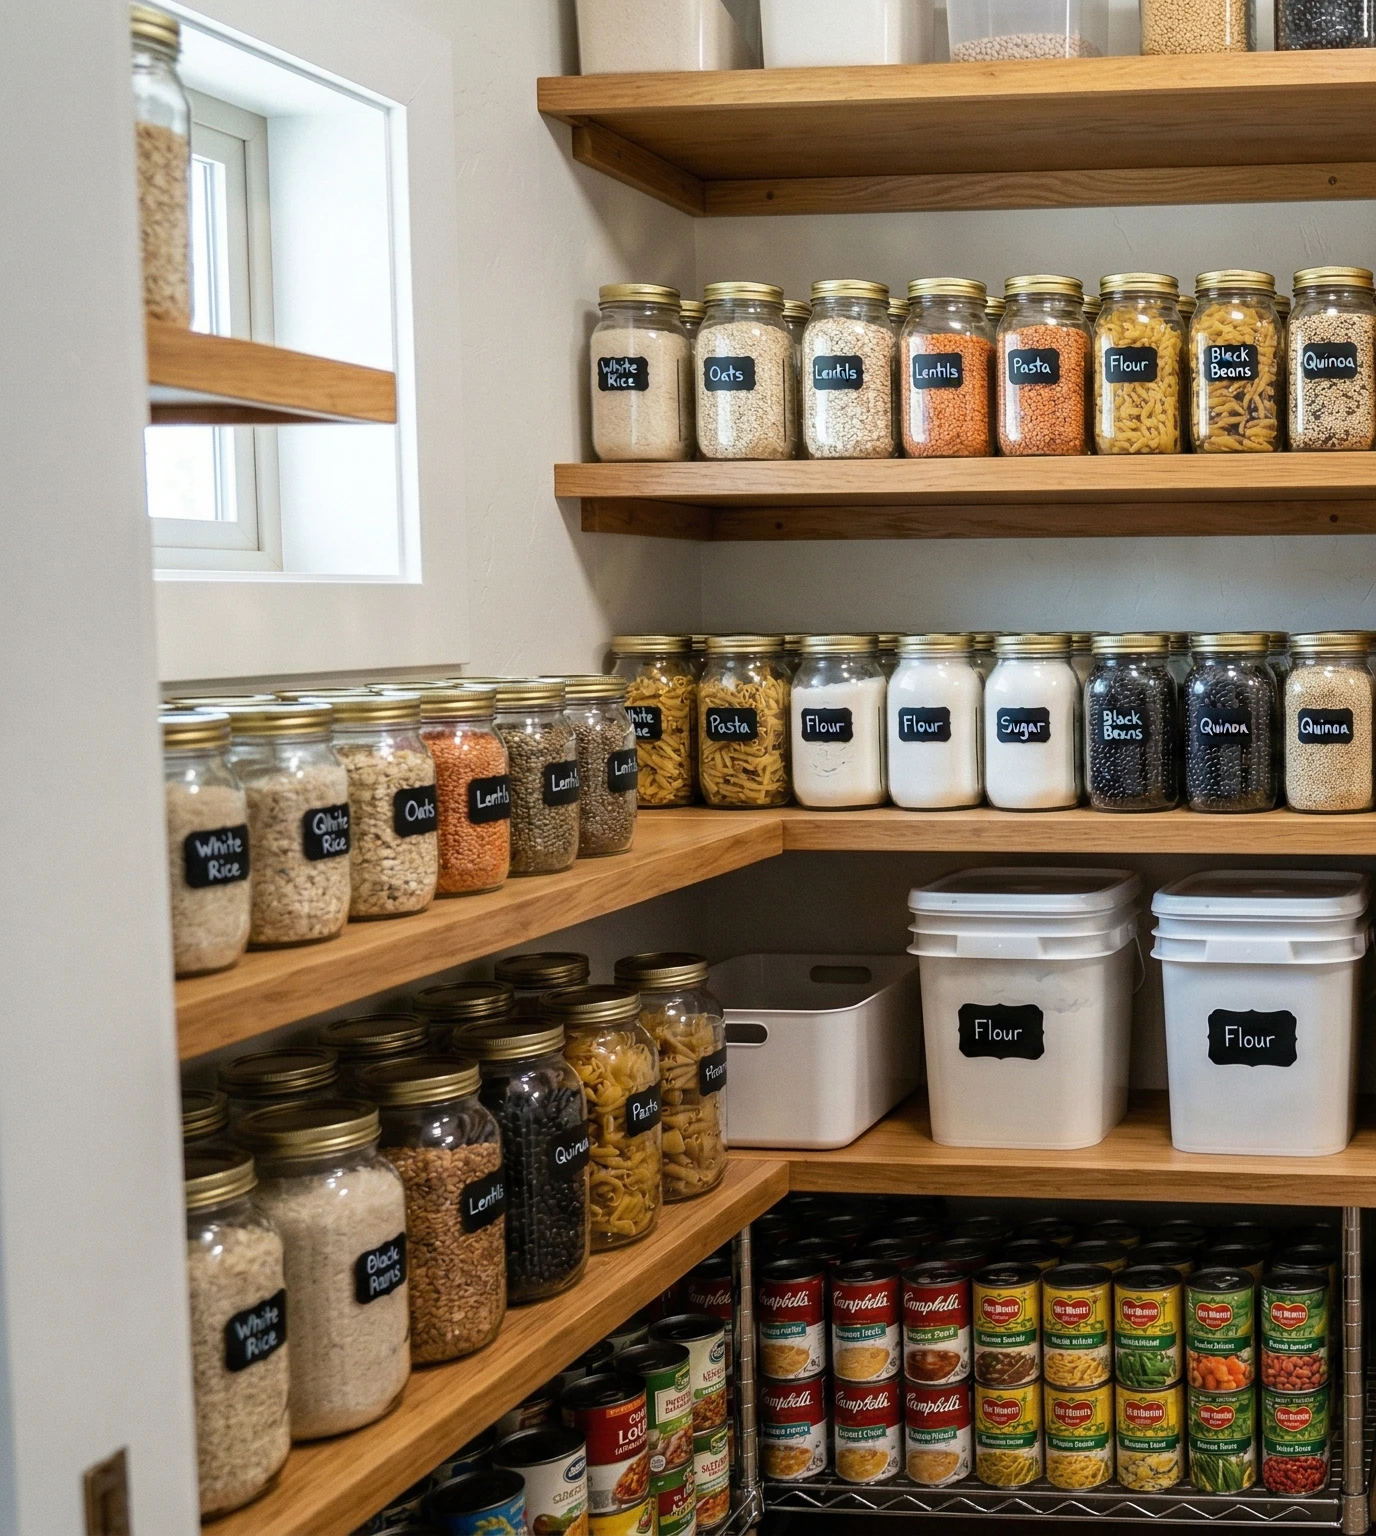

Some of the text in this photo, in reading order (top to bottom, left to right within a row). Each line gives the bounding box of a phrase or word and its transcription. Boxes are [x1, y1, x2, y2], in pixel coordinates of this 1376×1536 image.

[601, 361, 638, 374] White
[709, 366, 744, 382] Oats
[915, 362, 959, 380] Lentils
[1013, 357, 1052, 375] Pasta
[1109, 356, 1149, 373] Flour
[1210, 364, 1252, 379] Beans
[607, 373, 636, 388] Rice
[710, 714, 752, 733] Pasta
[806, 715, 845, 734] Flour
[903, 714, 944, 734] Flour
[1001, 716, 1045, 740] Sugar
[404, 798, 435, 822] Oats
[195, 832, 244, 857] White
[322, 835, 347, 855] Rice
[208, 858, 242, 880] Rice
[974, 1018, 1023, 1042] Flour
[1225, 1025, 1276, 1049] Flour
[233, 1305, 279, 1341] White
[245, 1330, 278, 1360] Rice
